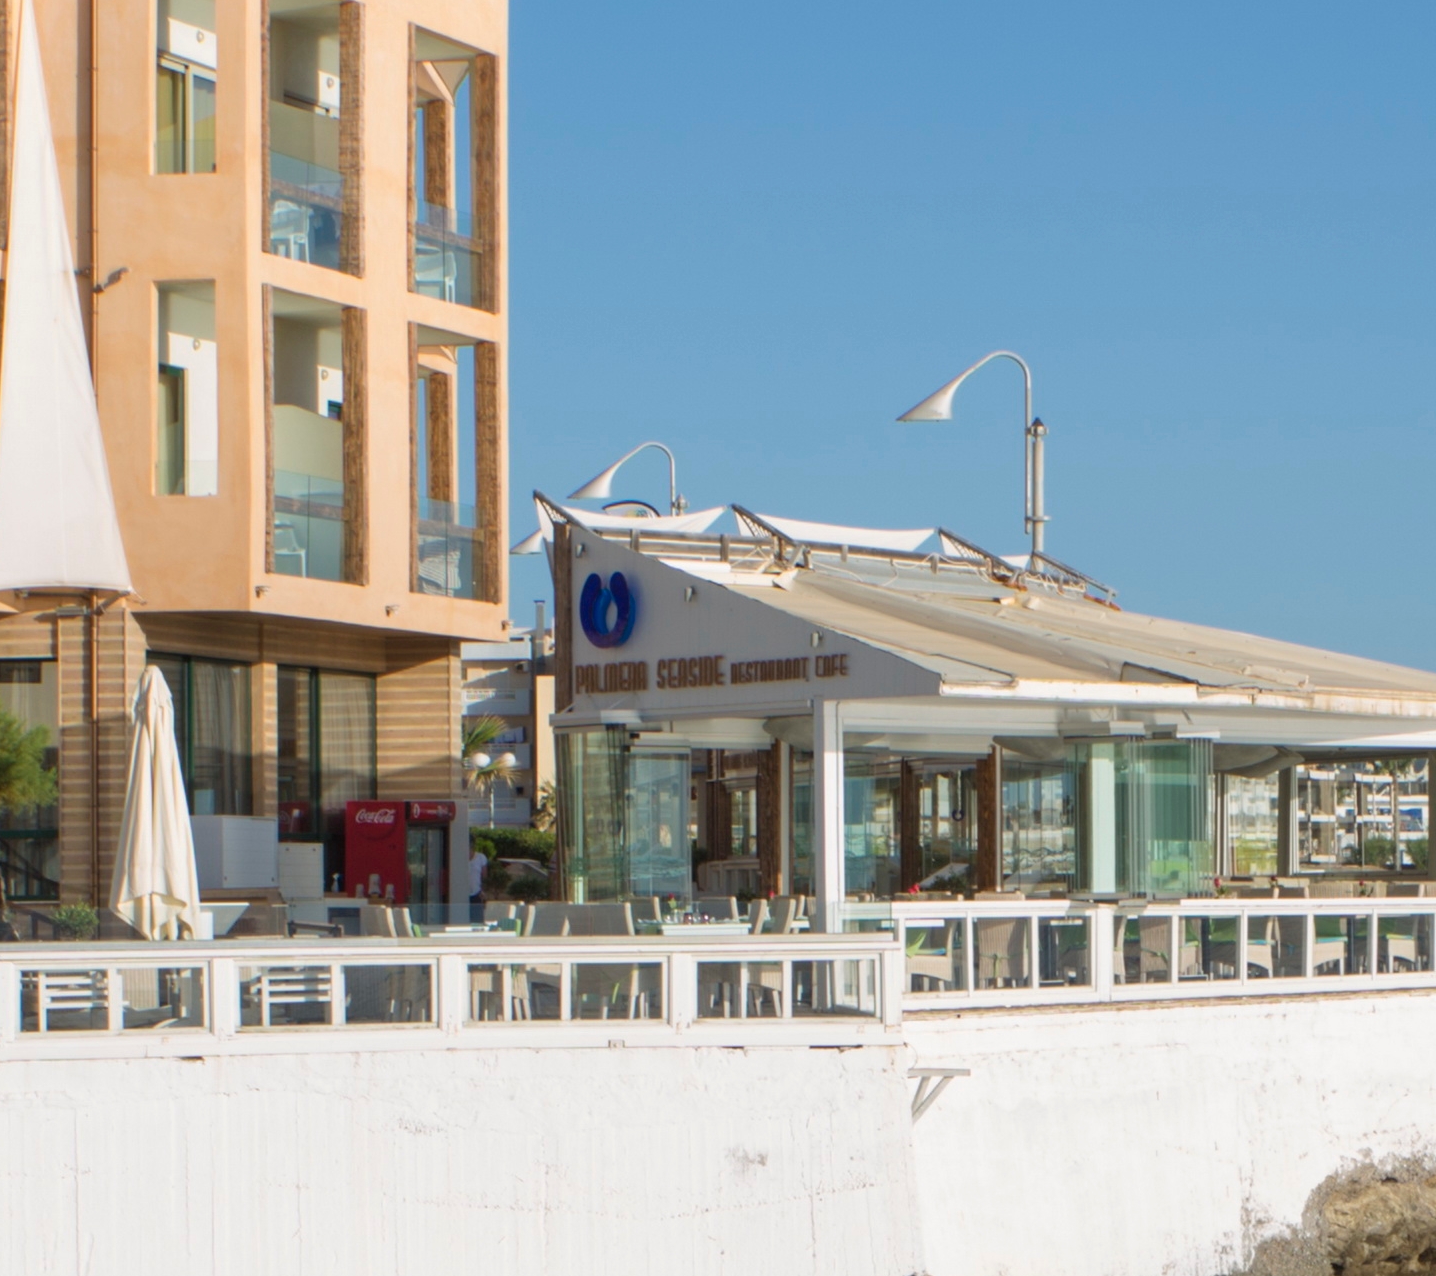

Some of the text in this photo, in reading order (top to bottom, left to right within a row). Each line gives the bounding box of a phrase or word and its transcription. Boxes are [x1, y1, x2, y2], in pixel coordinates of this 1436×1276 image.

[575, 661, 648, 694] PALMERA
[657, 655, 725, 689] SEASIDE
[815, 654, 848, 678] CAFE
